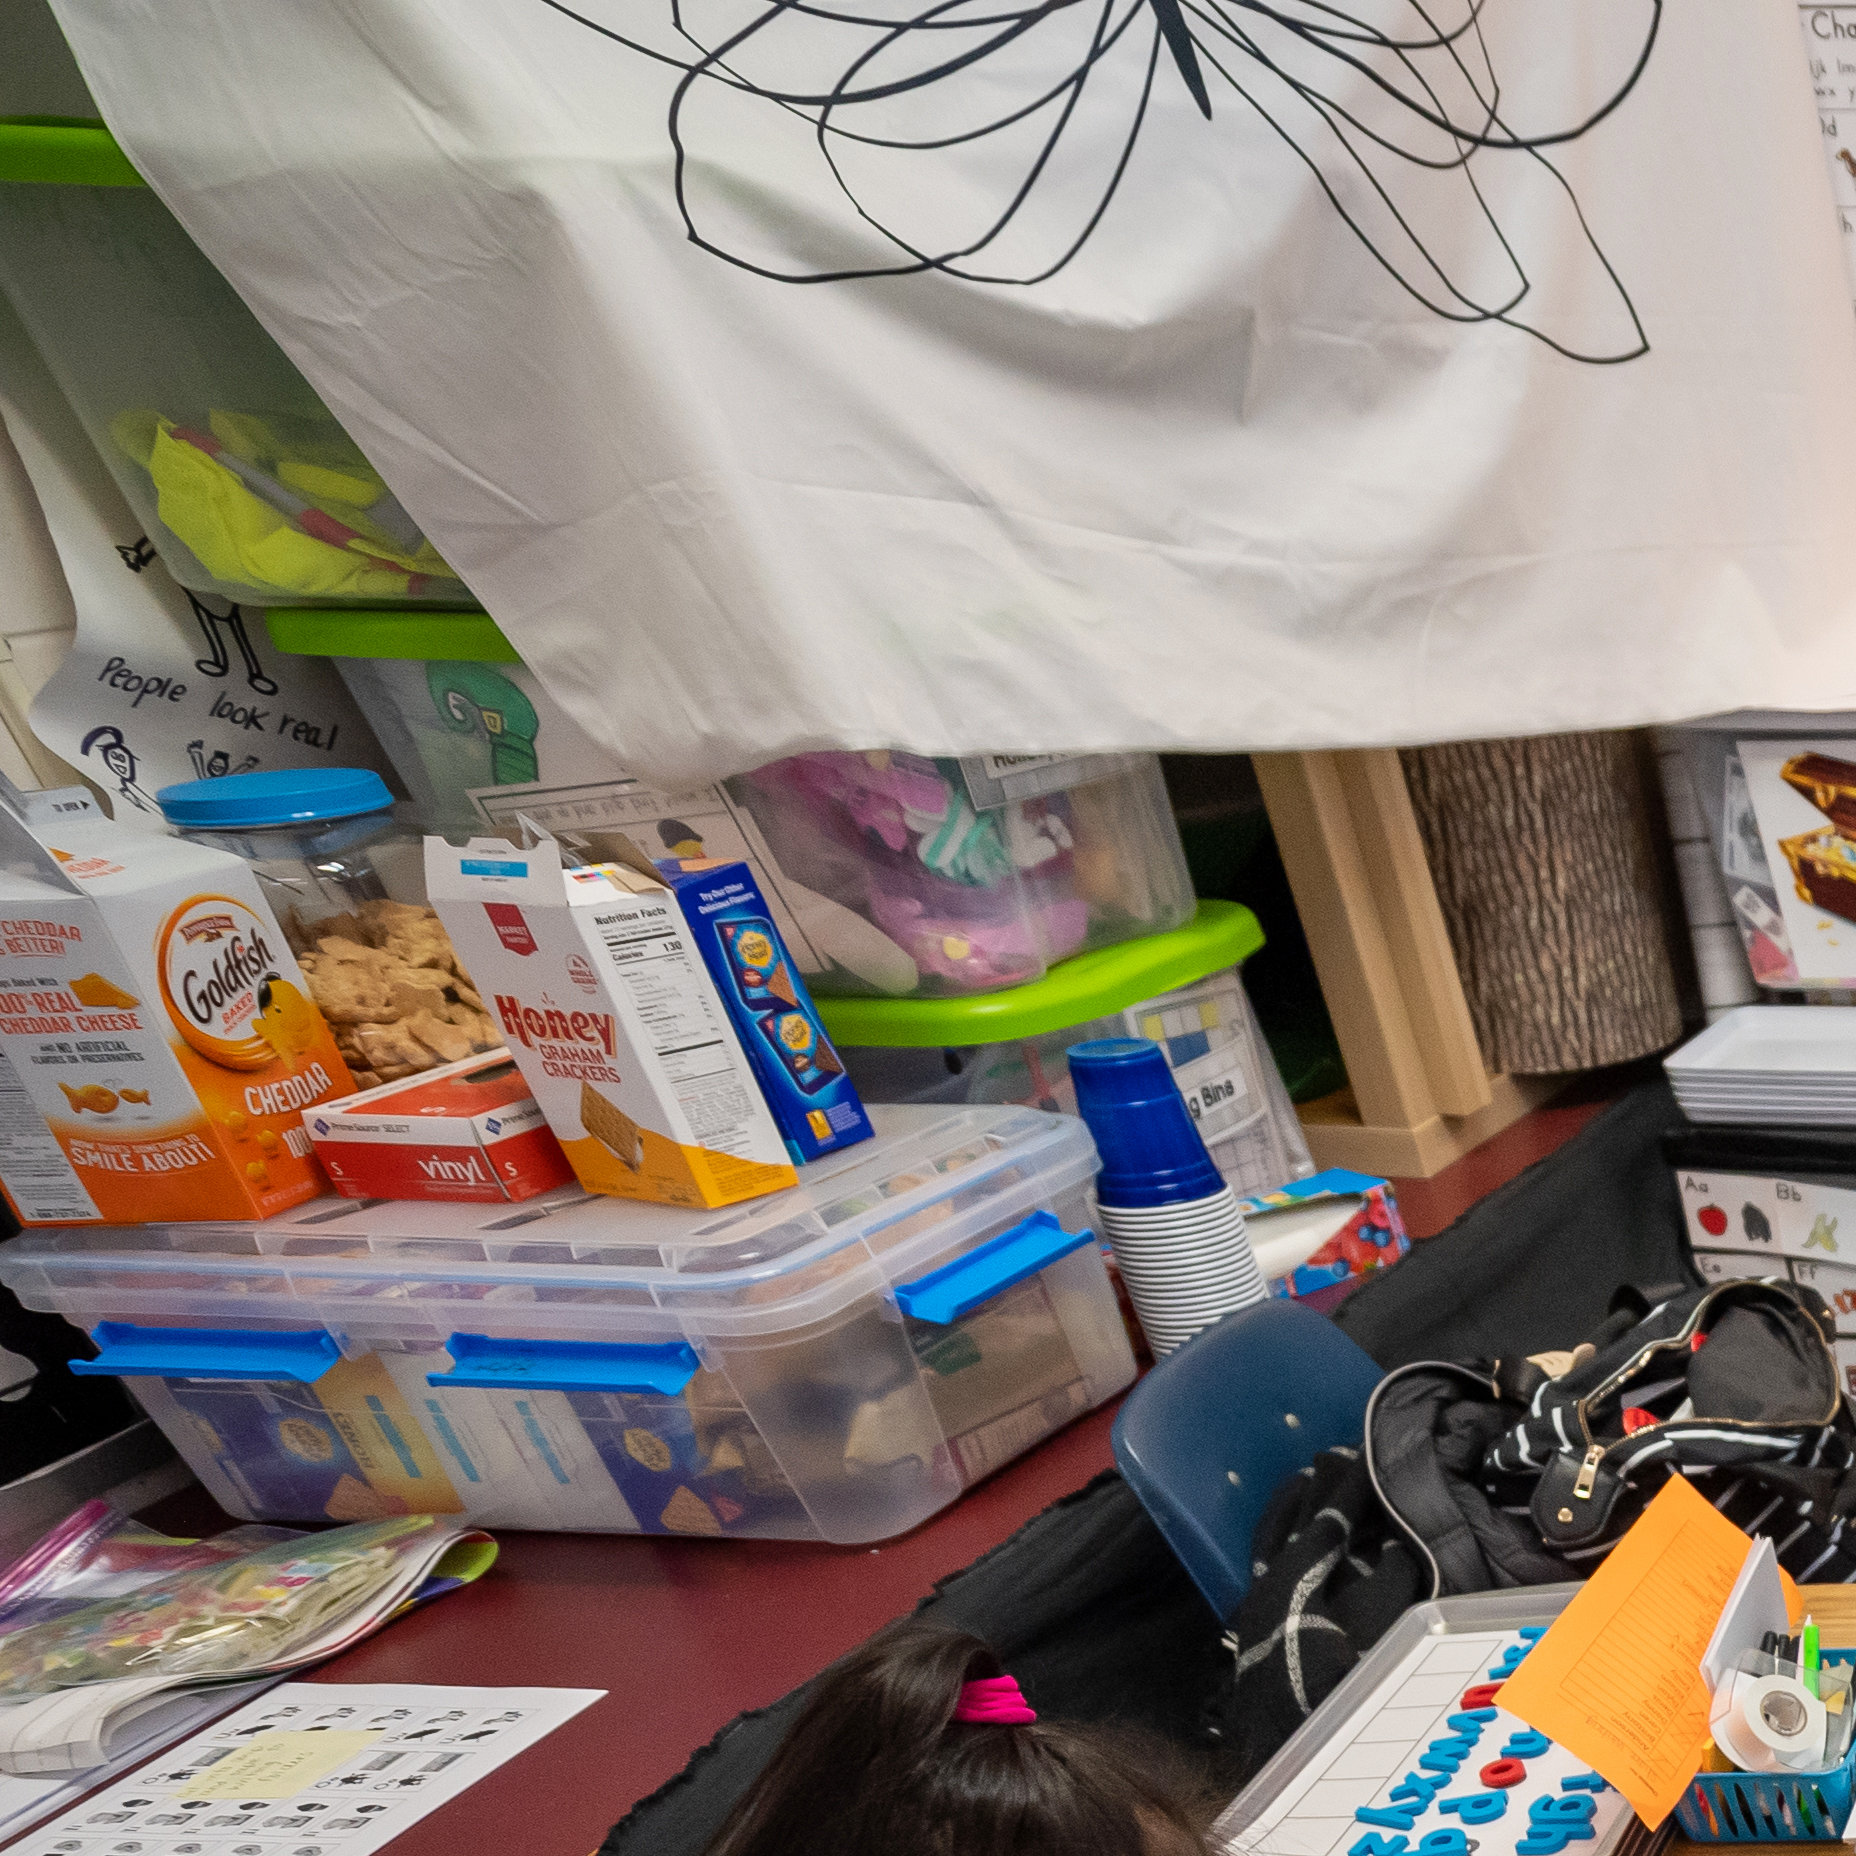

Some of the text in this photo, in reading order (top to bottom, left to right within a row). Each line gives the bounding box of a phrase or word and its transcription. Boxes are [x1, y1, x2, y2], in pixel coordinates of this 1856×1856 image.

[97, 655, 339, 752] People look real
[594, 906, 667, 926] Nutrition Facts
[0, 919, 82, 942] CHEDDAR
[663, 940, 683, 953] 130
[183, 927, 275, 1025] Goldfish
[30, 990, 83, 1014] REAL
[75, 1013, 143, 1033] CHEESE
[493, 994, 618, 1059] Honey
[538, 1044, 607, 1065] GRAHAM
[541, 1060, 622, 1084] CRACKERS
[243, 1062, 334, 1116] CHEDDAR
[1200, 1077, 1236, 1108] Bins
[70, 1147, 139, 1173] SMILE
[329, 1161, 344, 1177] S
[417, 1154, 488, 1187] vinyl
[504, 1161, 519, 1177] S
[1684, 1176, 1709, 1194] Aa
[1776, 1183, 1802, 1203] Bb
